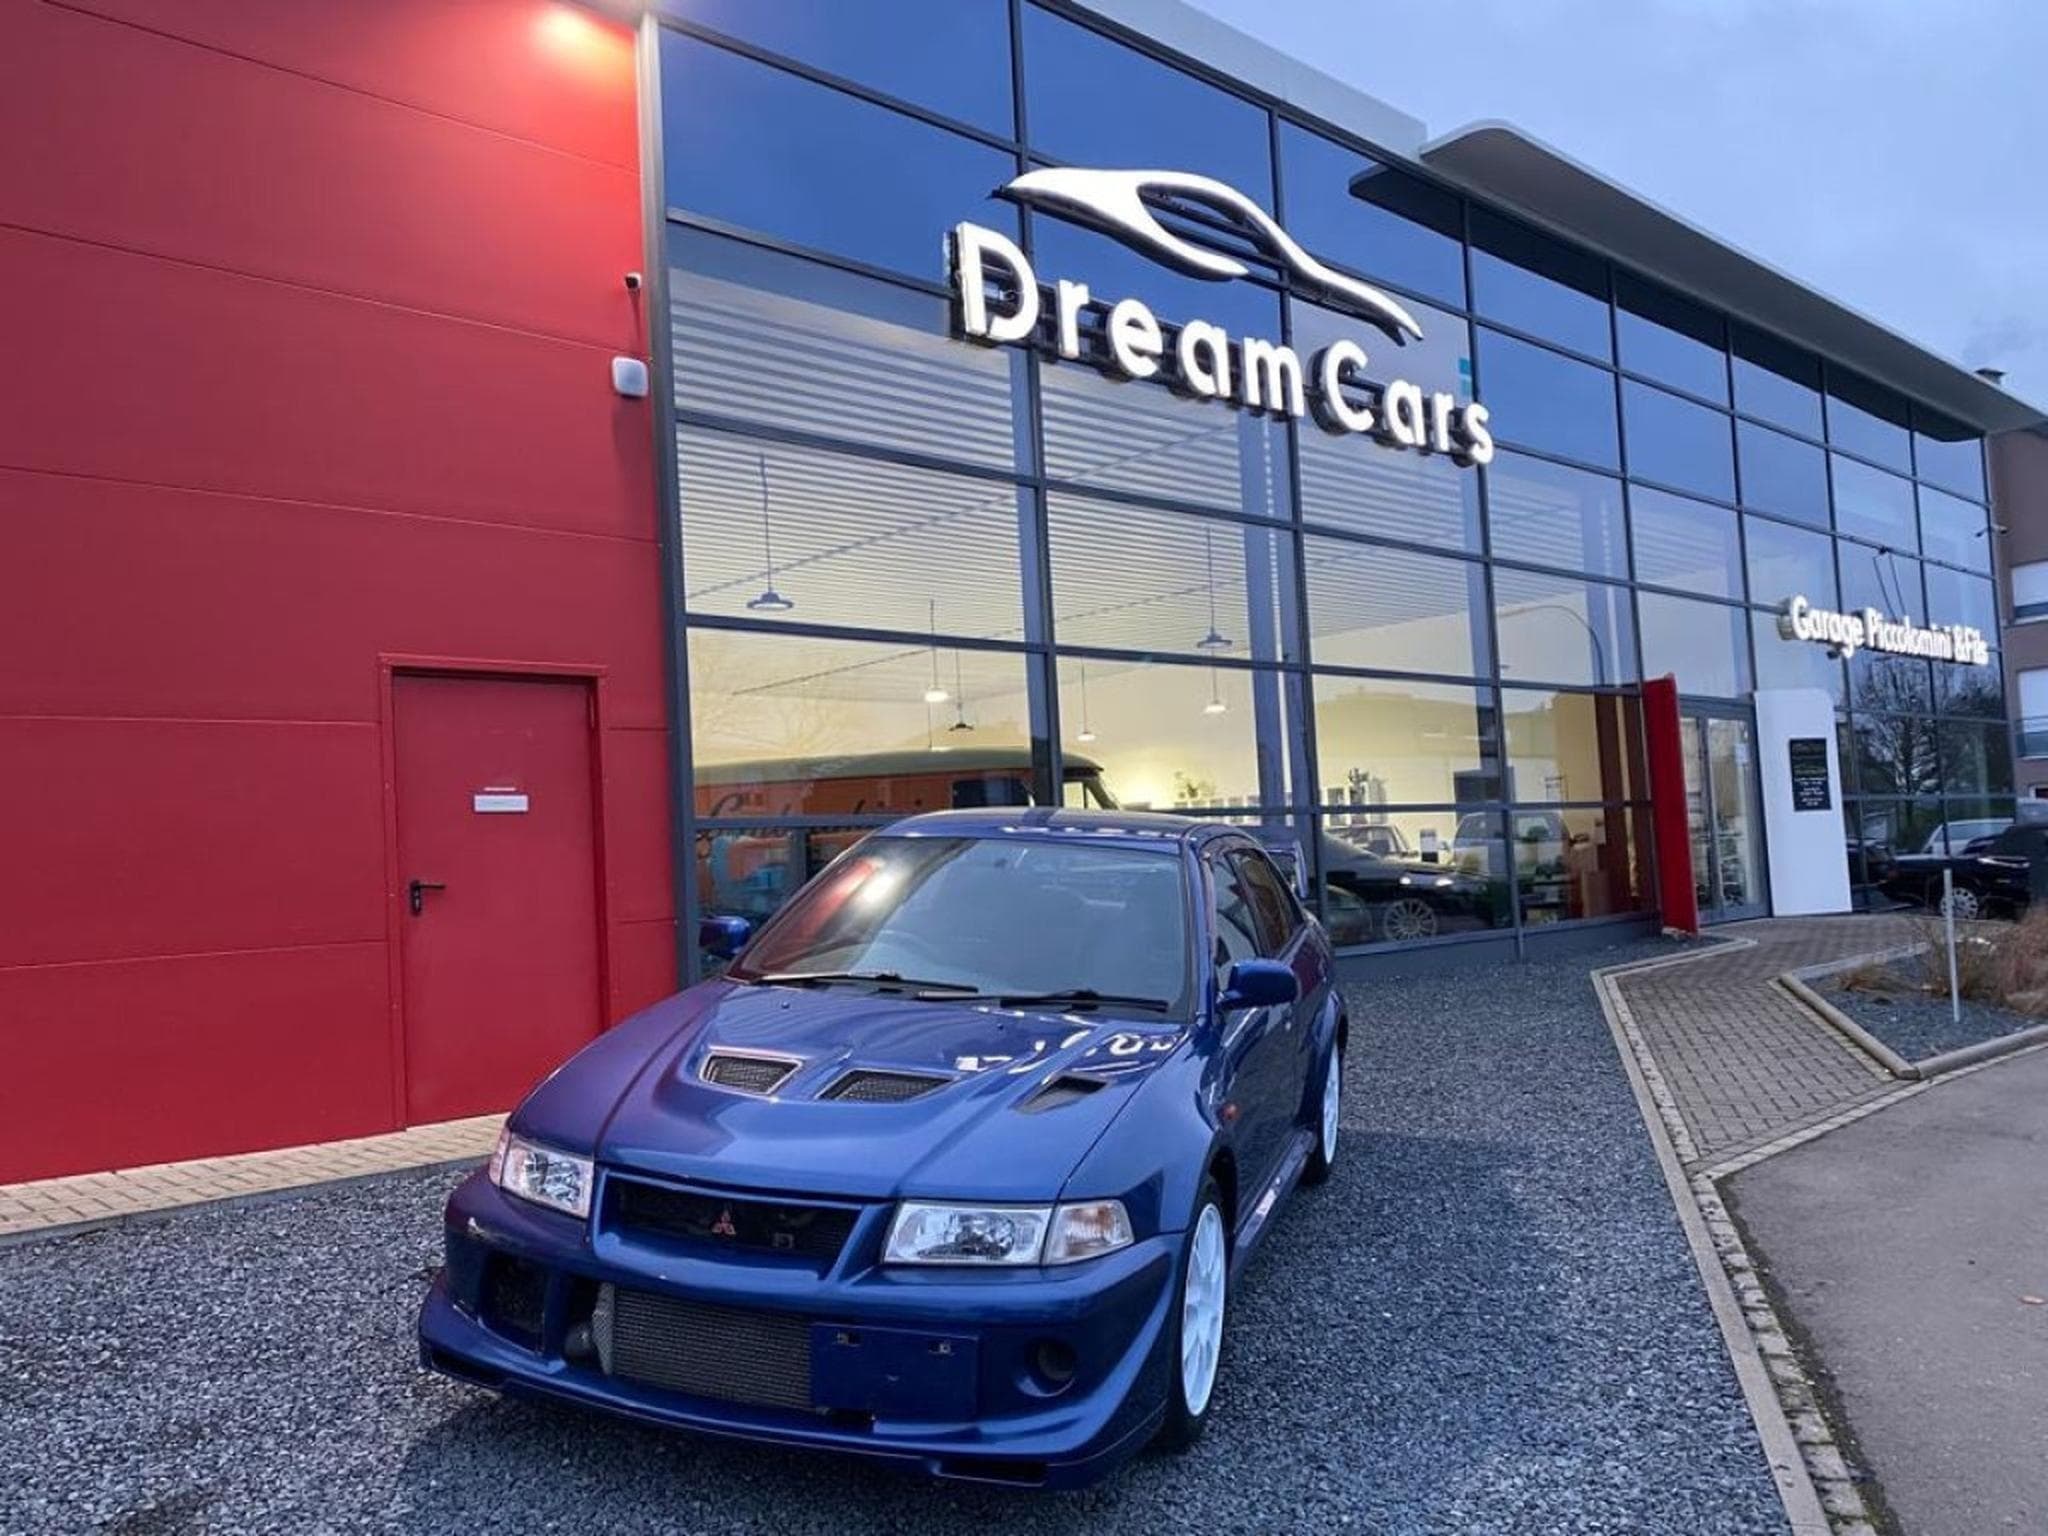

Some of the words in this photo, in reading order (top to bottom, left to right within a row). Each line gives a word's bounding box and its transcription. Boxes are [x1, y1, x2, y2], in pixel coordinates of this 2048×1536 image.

[957, 220, 1304, 418] Dream
[1321, 338, 1494, 464] Cars
[1791, 595, 1865, 658] Garage
